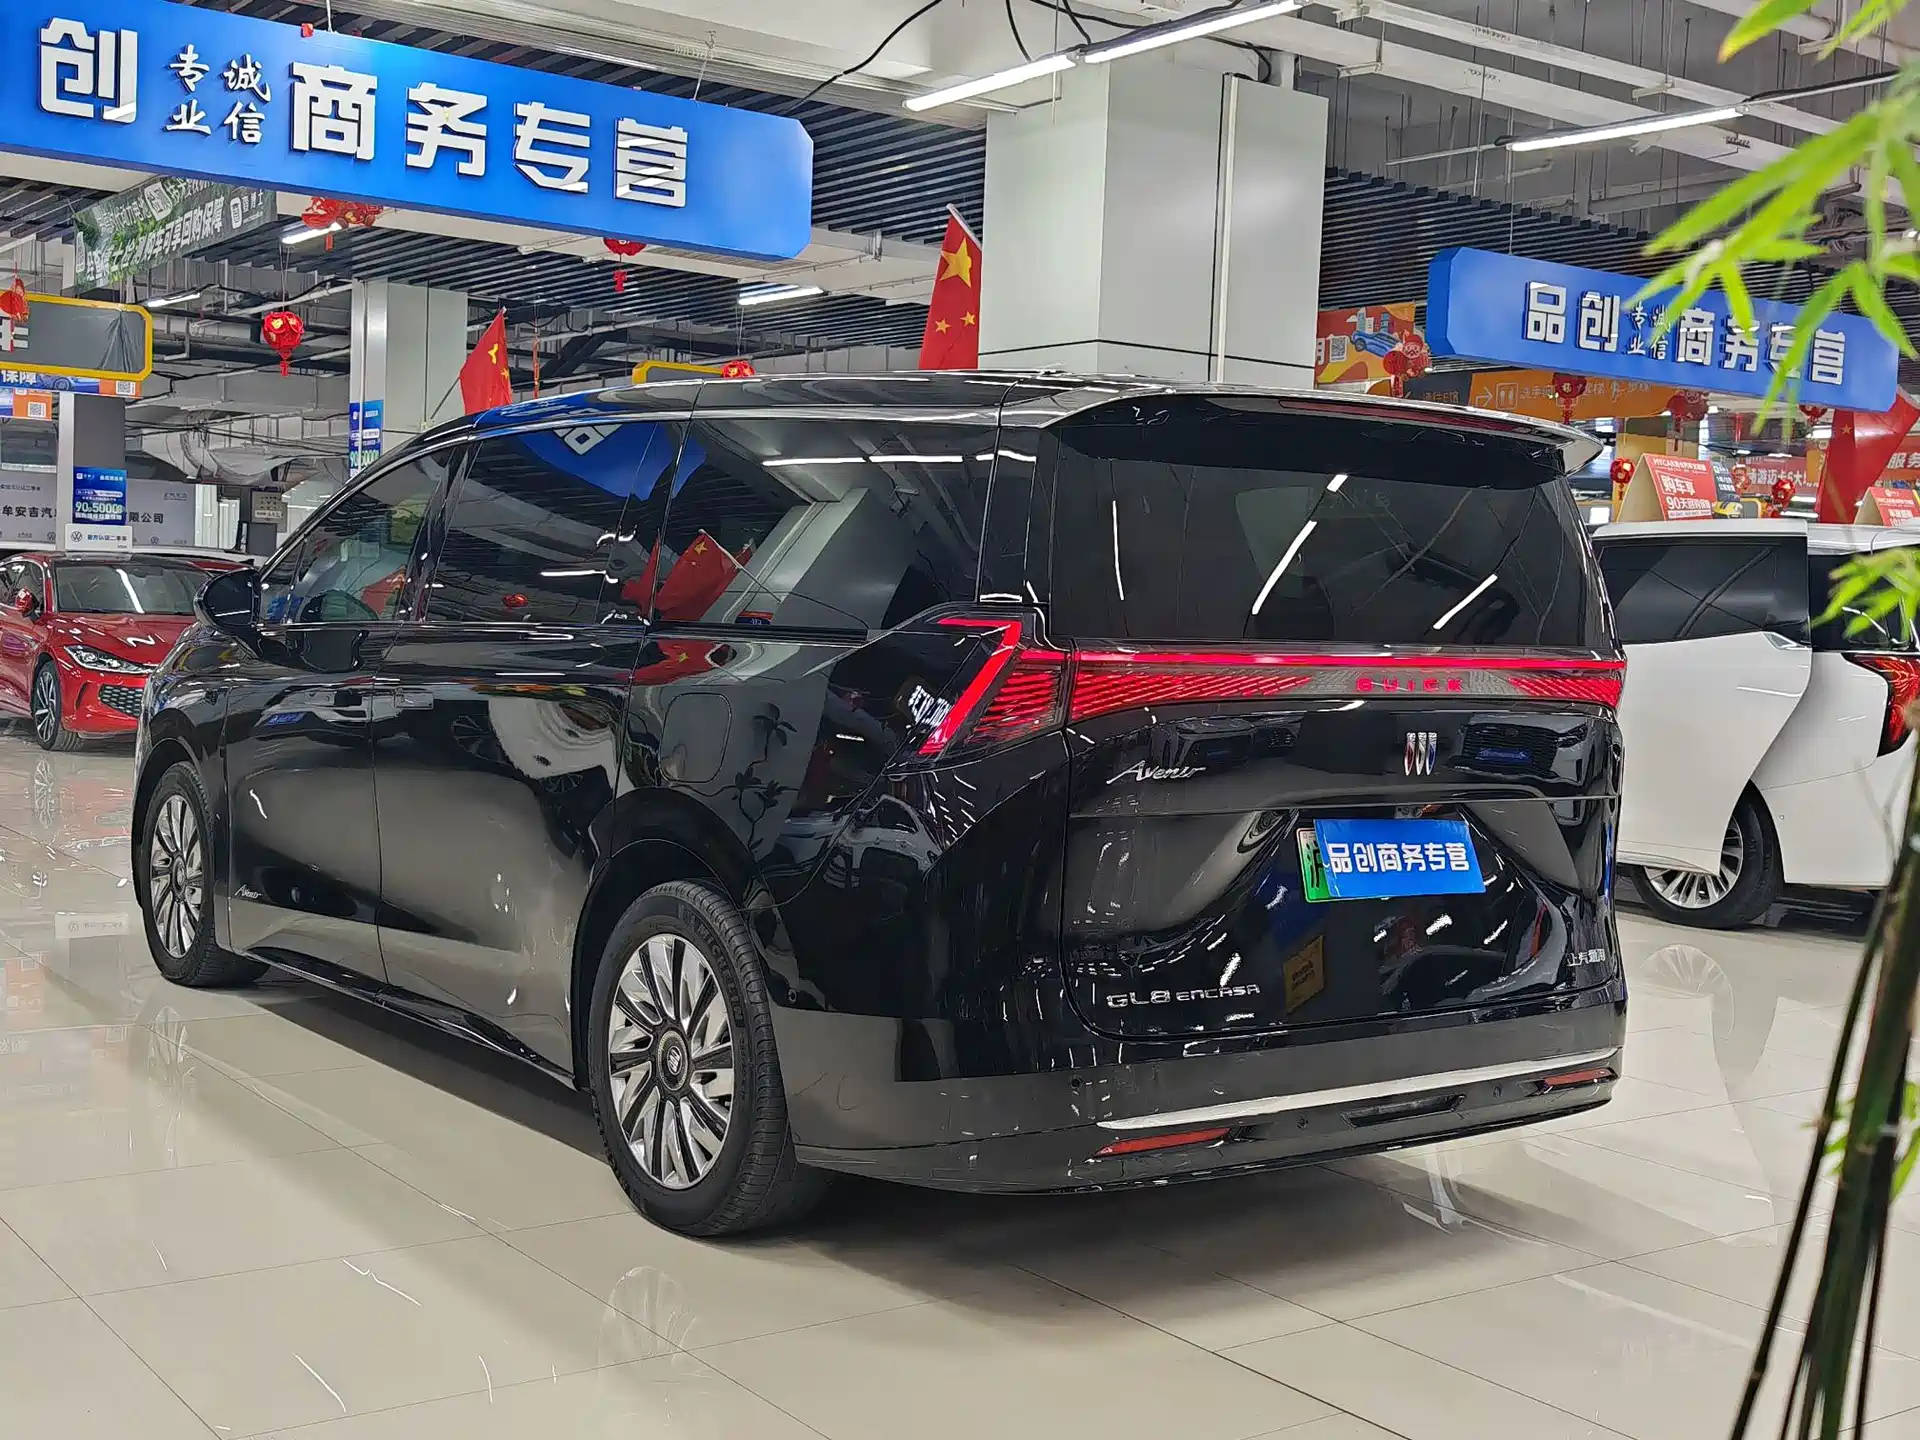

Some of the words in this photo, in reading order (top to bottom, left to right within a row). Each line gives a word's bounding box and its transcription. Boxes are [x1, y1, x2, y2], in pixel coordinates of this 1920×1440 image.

[38, 17, 139, 125] 创
[289, 61, 688, 208] 商务专营
[1525, 281, 1620, 352] 品创
[2, 505, 57, 518] 牟安吉汽
[1106, 759, 1207, 785] Avenir
[1327, 842, 1470, 872] 品创商务专营
[1106, 990, 1171, 1008] GL8
